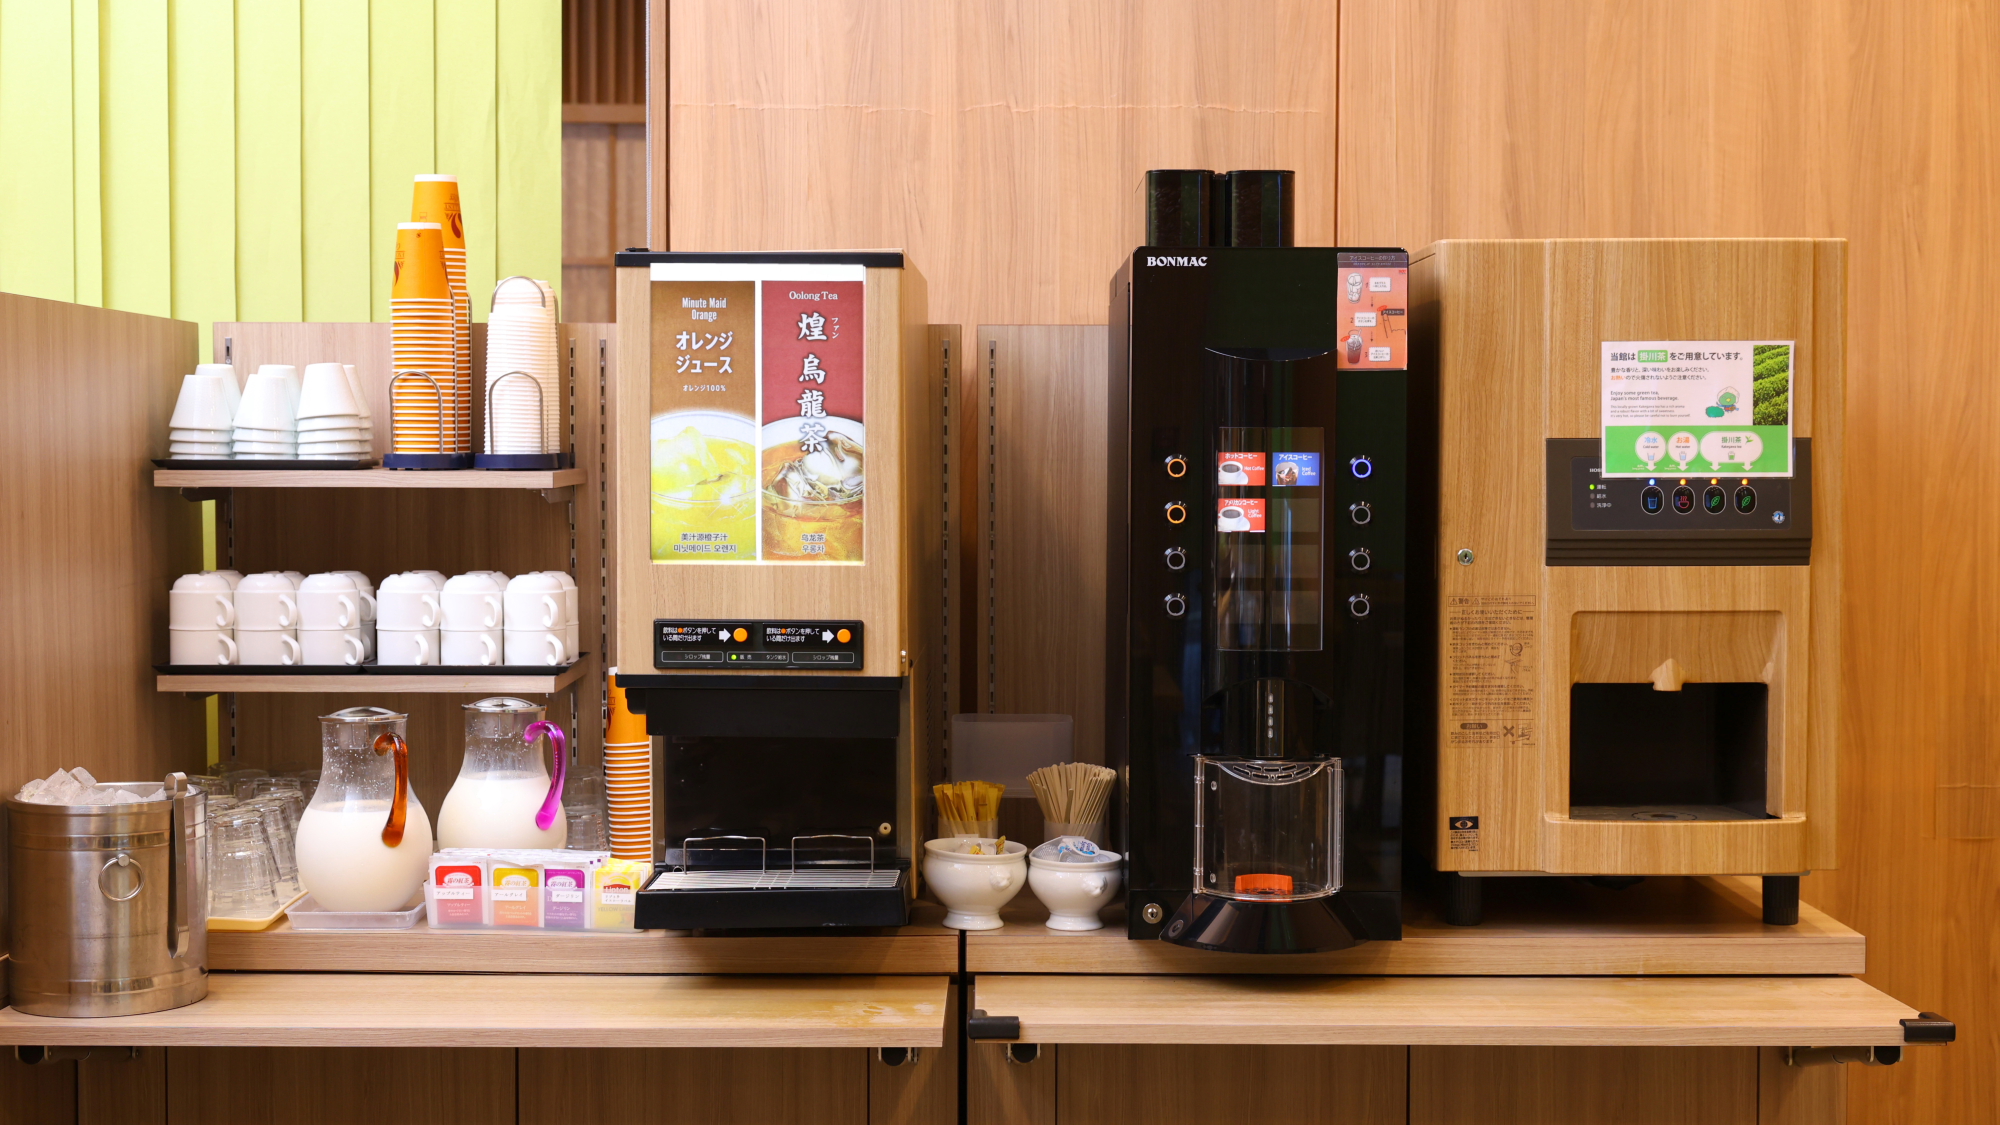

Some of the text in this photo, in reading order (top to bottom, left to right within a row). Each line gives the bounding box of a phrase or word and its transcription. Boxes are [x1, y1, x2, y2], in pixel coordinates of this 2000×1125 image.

[1146, 256, 1208, 266] BONMAC
[789, 291, 838, 300] Oolong Tea
[682, 298, 727, 308] Minute Maid
[692, 310, 717, 322] Orange
[676, 331, 733, 350] オレンジ
[1611, 352, 1743, 361] 当館は 掛川茶 をご用意しています。
[676, 354, 733, 374] ジュース
[801, 534, 825, 542] 乌龙茶
[674, 544, 737, 553] 미닛메이드 오렌지
[802, 545, 825, 553] 우롱차
